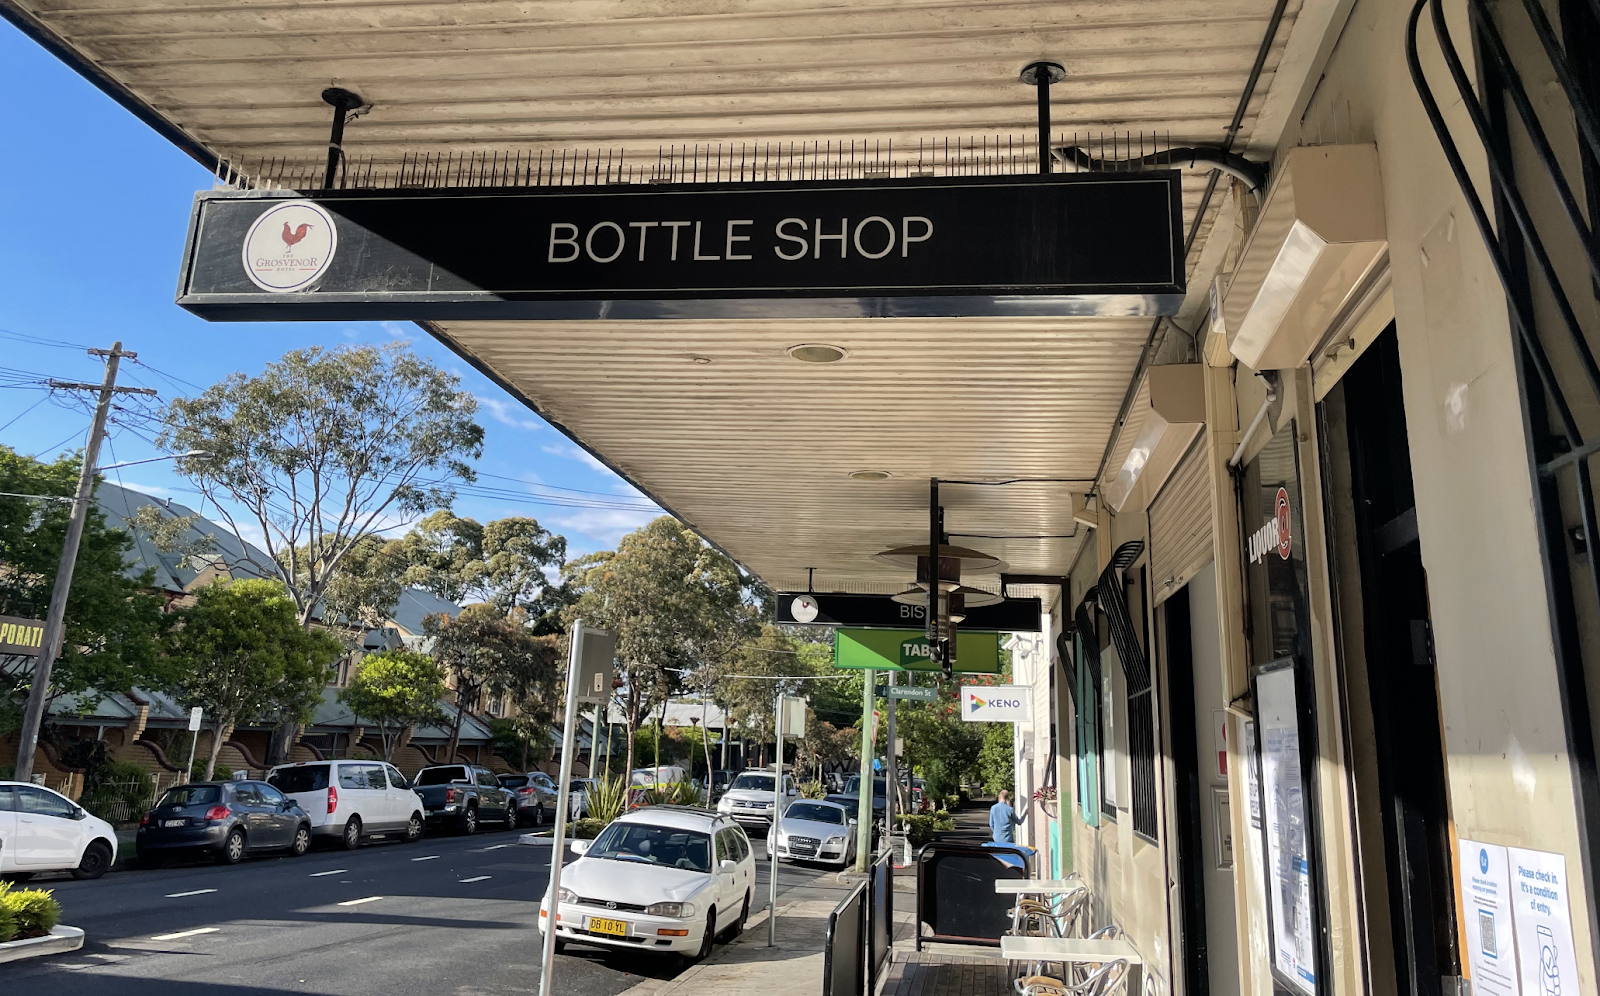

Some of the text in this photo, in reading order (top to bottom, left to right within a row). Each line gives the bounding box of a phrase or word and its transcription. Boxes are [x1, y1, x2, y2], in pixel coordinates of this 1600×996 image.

[547, 215, 934, 263] BOTTLE SHOP
[256, 257, 318, 267] GROSVENOR
[1248, 516, 1280, 565] LIQUOR
[900, 605, 926, 618] BIS
[902, 643, 931, 657] TAB
[890, 687, 923, 697] Clarendon
[924, 689, 932, 697] St
[988, 699, 1020, 708] KENO
[1518, 865, 1559, 884] Please check in.
[1520, 881, 1529, 893] It's
[1533, 886, 1559, 901] condition
[1530, 899, 1552, 917] of entry.
[591, 919, 601, 929] DB
[615, 922, 624, 933] YL
